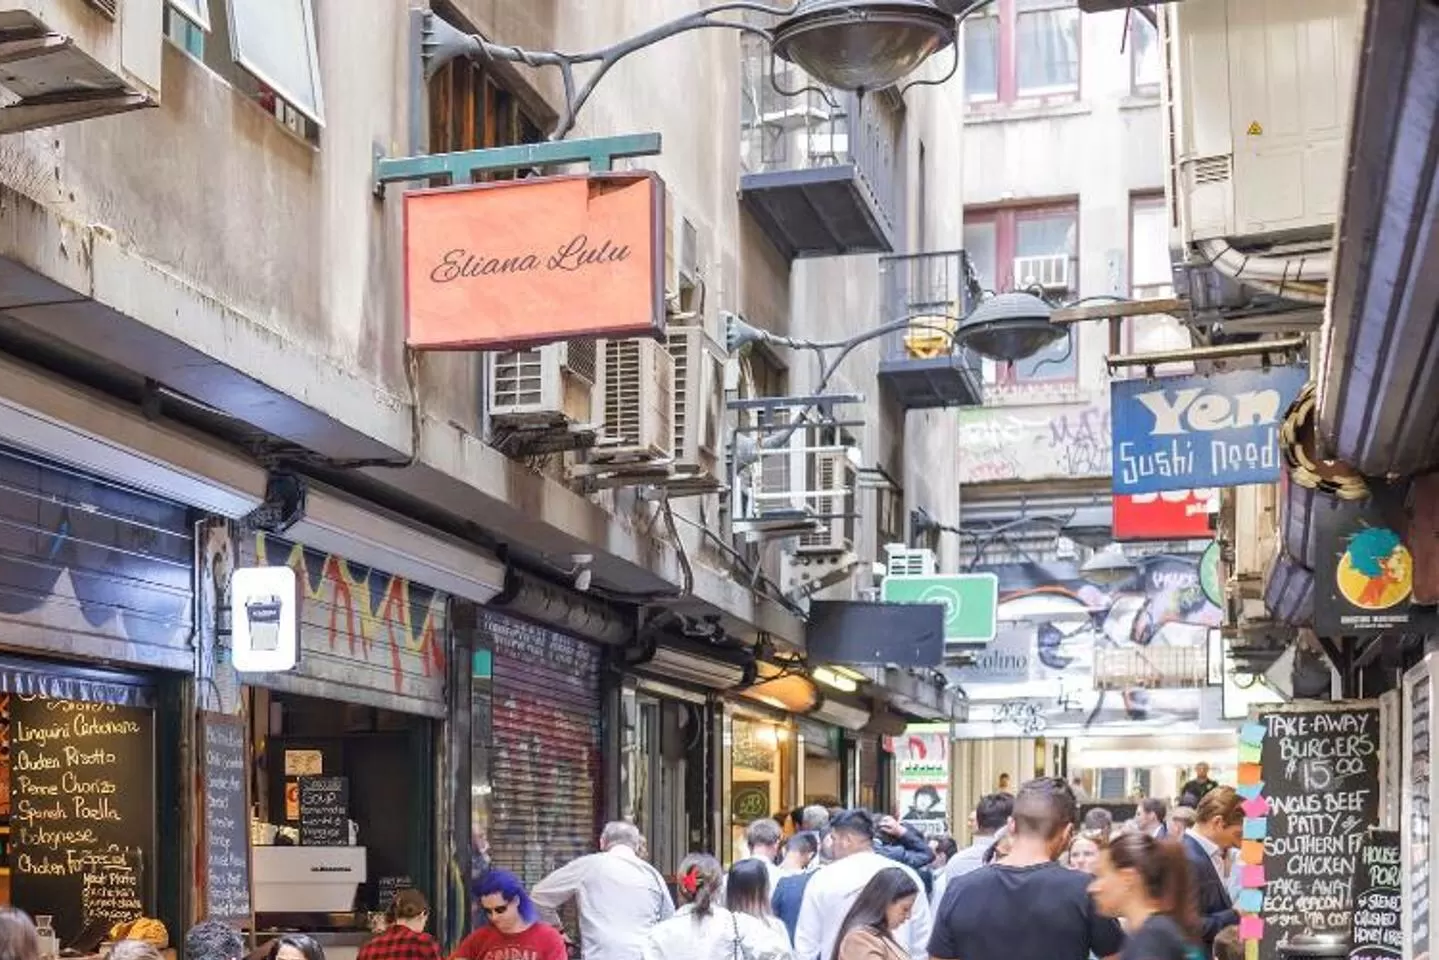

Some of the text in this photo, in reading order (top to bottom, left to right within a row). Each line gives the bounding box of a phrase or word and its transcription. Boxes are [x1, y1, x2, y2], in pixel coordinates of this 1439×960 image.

[430, 233, 631, 283] Eliana Lulu
[1134, 387, 1282, 436] Yen
[1119, 437, 1195, 485] Sushi
[1279, 733, 1375, 760] BURGERS
[1323, 790, 1371, 813] BEEF
[1286, 812, 1341, 835] PATTY
[1263, 834, 1345, 856] SOUTHERN
[1286, 855, 1356, 876] CHICKEN
